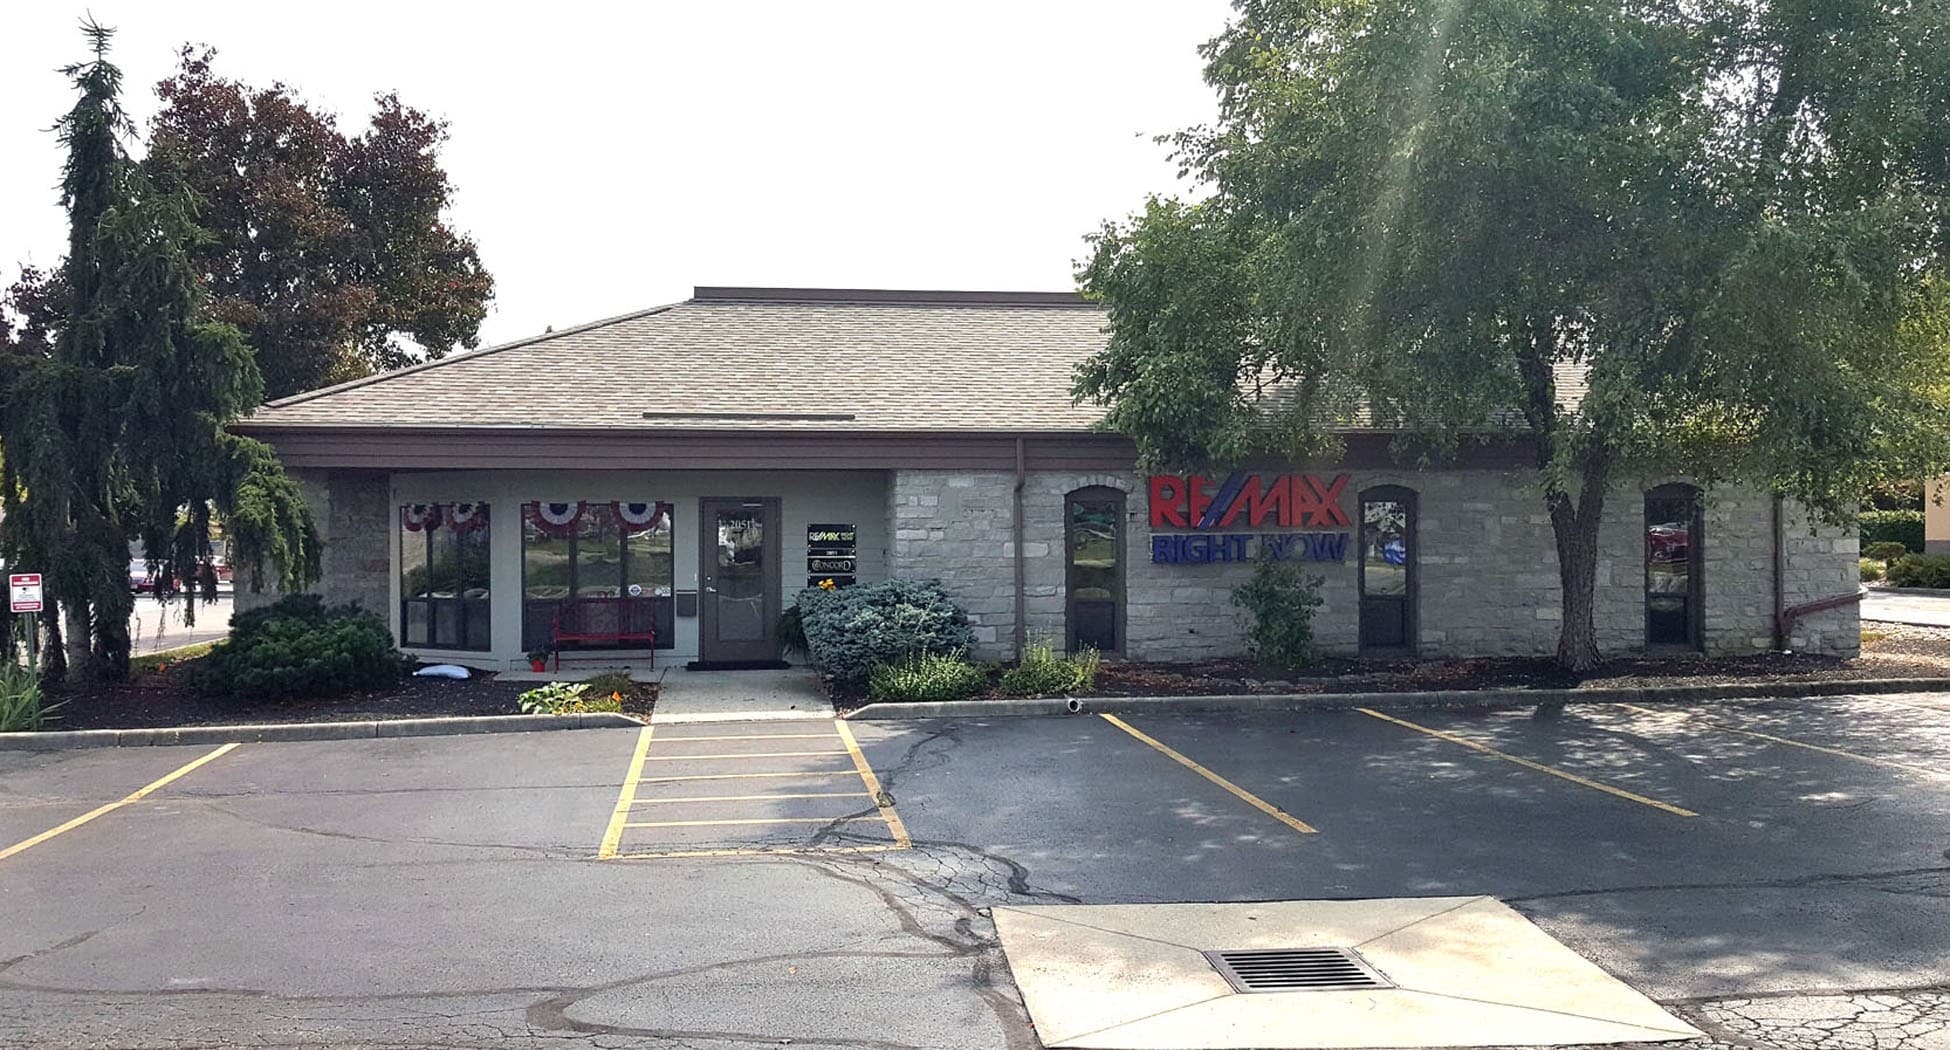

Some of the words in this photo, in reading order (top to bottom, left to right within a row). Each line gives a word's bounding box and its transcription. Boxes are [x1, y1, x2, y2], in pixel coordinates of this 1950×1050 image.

[1149, 471, 1351, 529] RE/MAX
[730, 519, 750, 528] 2051
[1152, 534, 1254, 565] RIGHT
[1262, 532, 1350, 563] NOW
